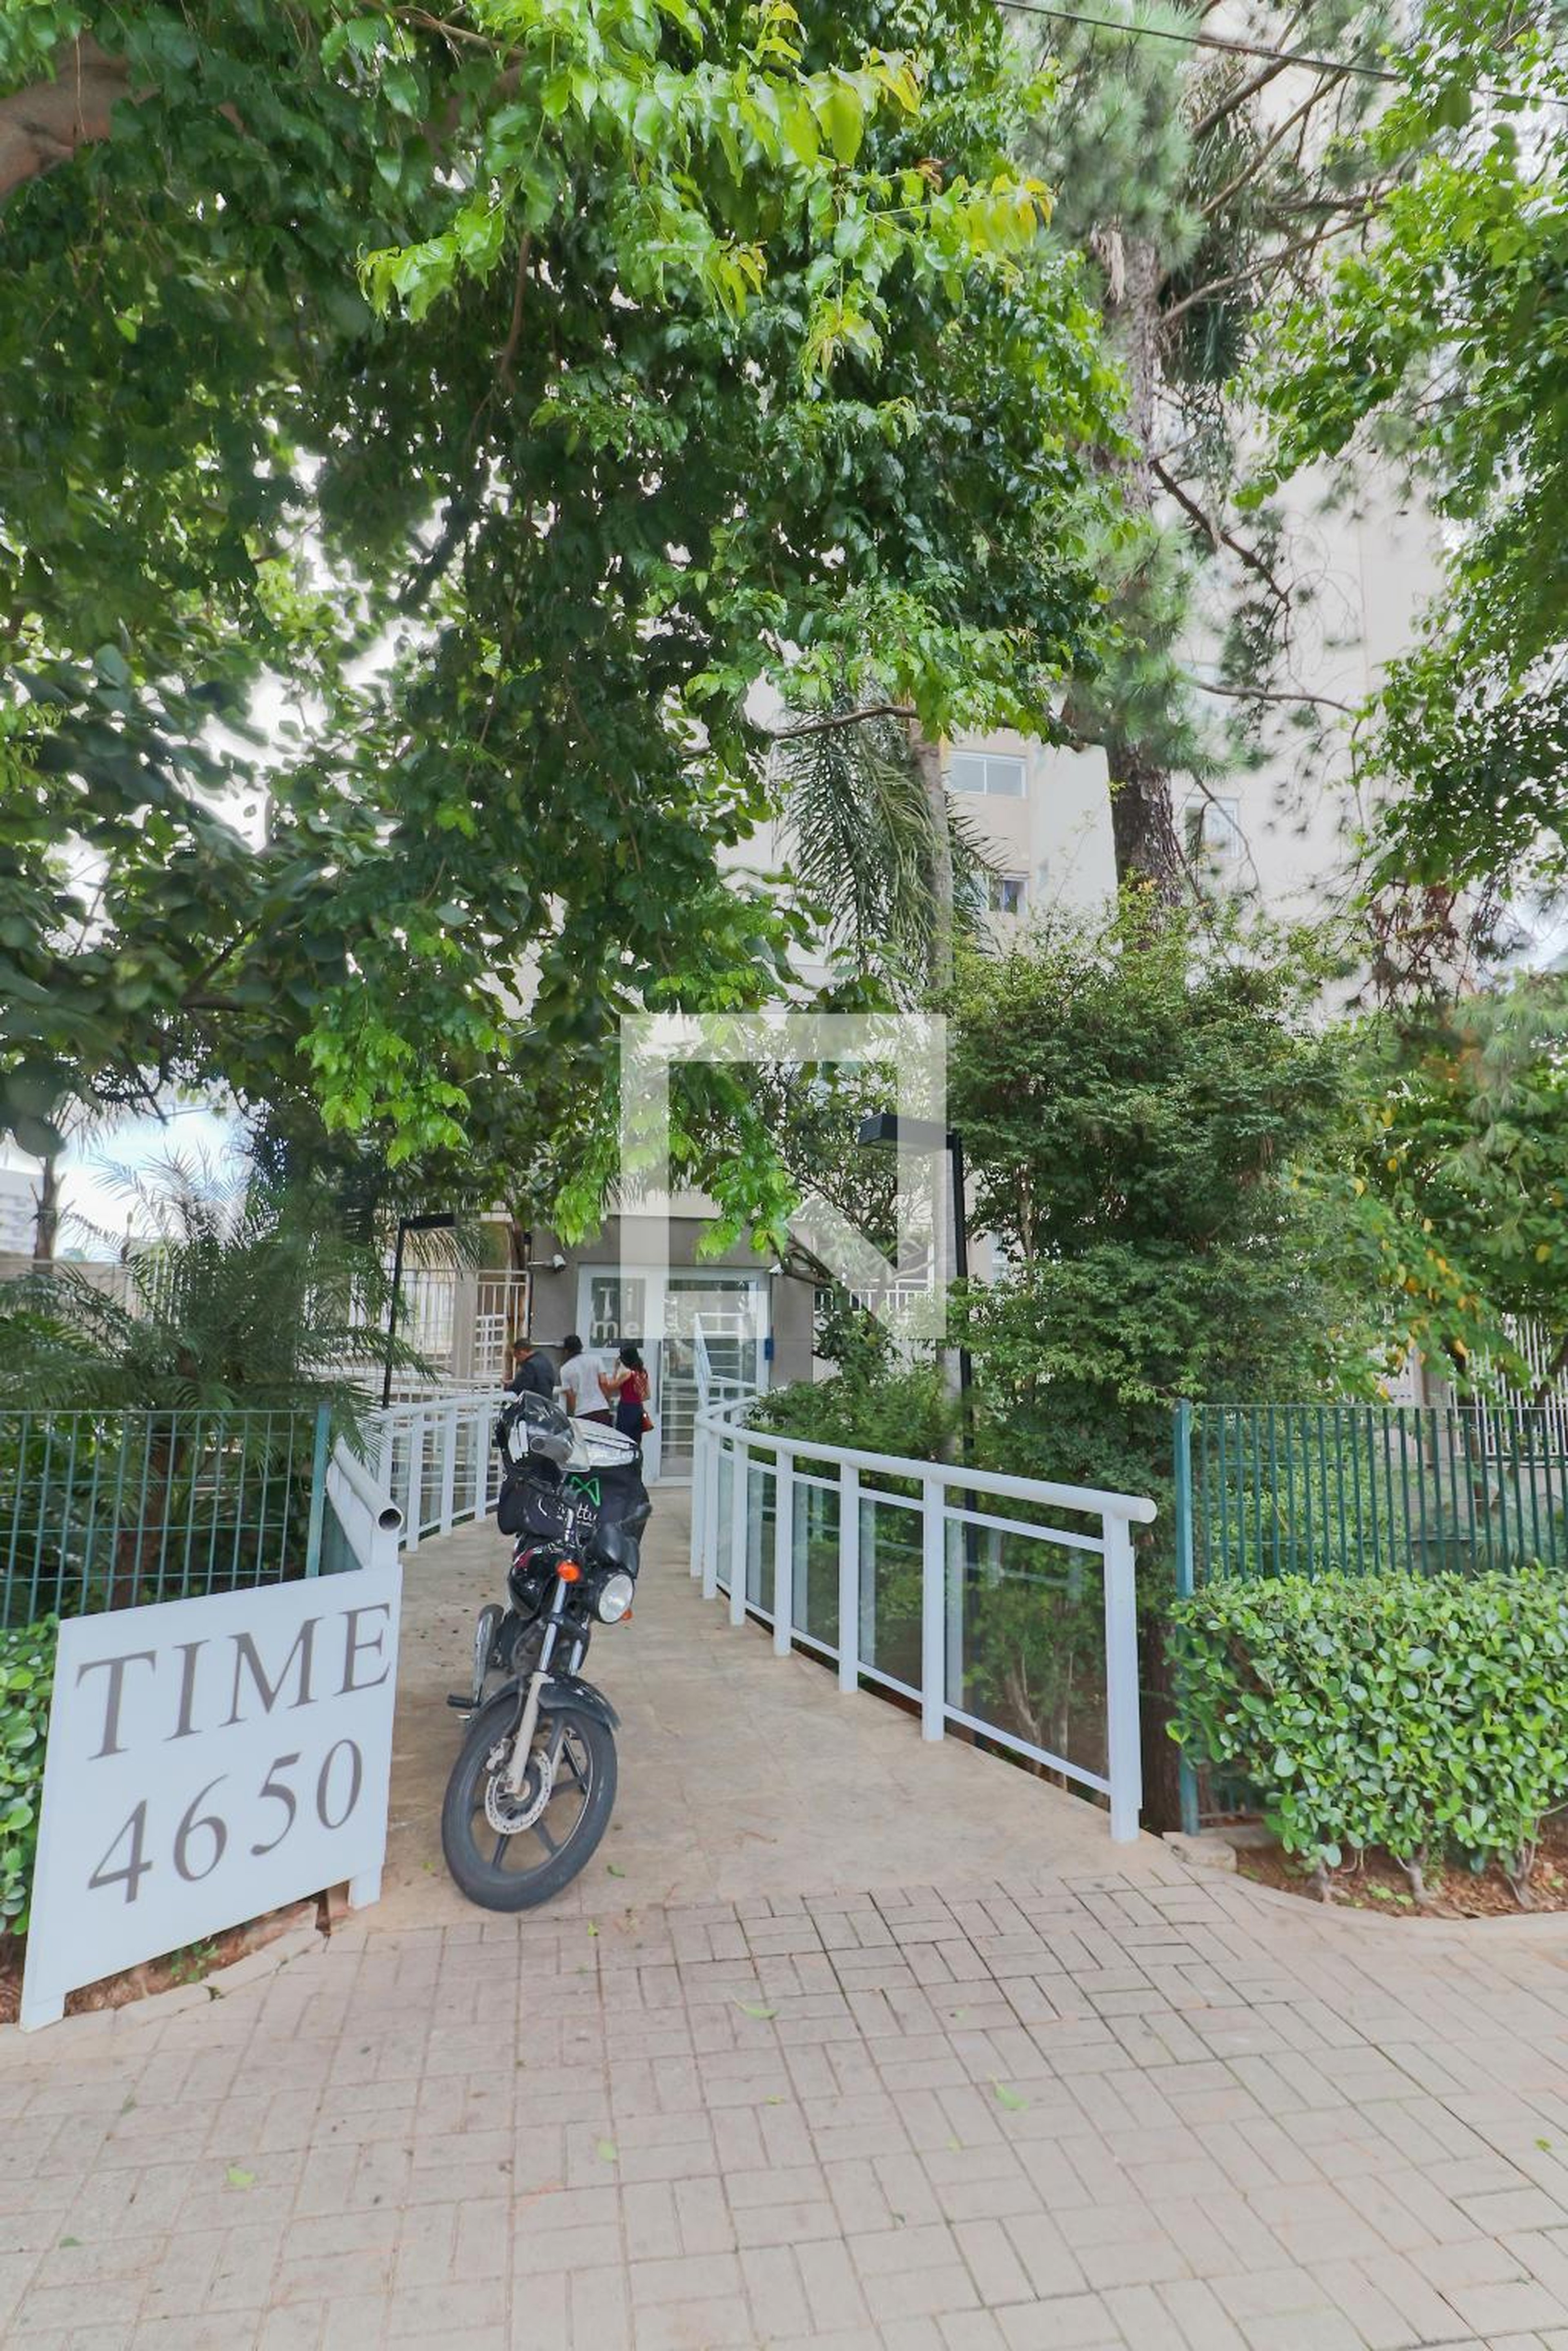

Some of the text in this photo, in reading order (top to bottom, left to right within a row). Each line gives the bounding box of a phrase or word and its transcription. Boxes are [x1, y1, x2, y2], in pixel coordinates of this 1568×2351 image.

[592, 1321, 640, 1338] me
[76, 1603, 391, 1760] TIME
[87, 1739, 363, 1903] 4650
